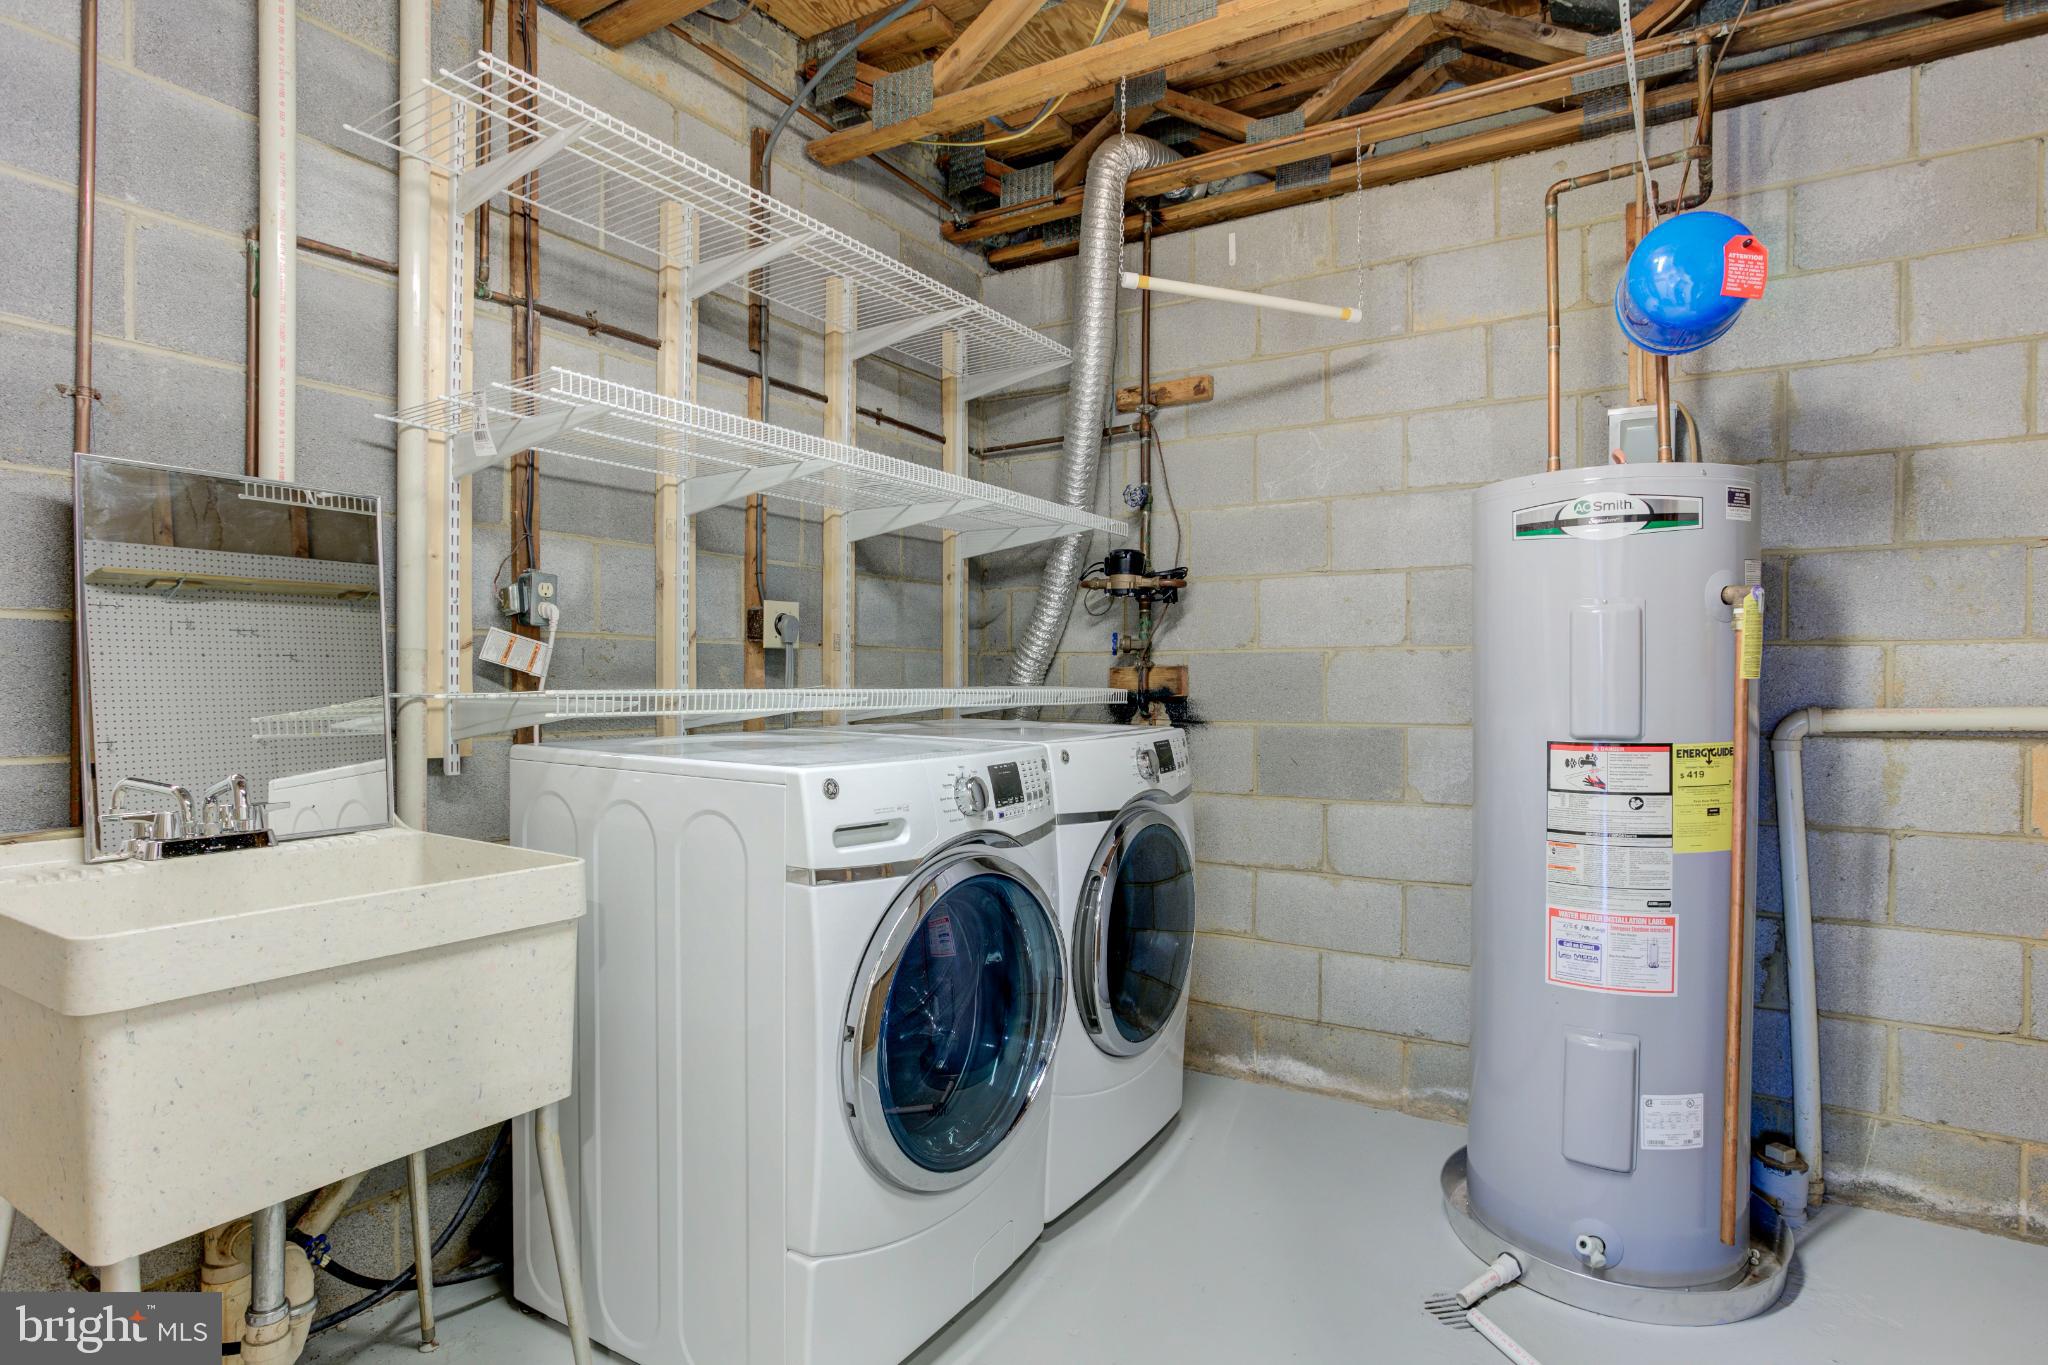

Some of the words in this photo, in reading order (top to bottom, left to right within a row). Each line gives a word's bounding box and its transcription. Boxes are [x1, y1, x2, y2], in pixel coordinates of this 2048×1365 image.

[1728, 252, 1764, 260] ATTENTION
[1593, 500, 1632, 512] Smith
[1686, 770, 1705, 779] 419
[1560, 910, 1579, 920] WATER
[1580, 912, 1602, 922] HEATER
[1648, 917, 1666, 926] LABEL
